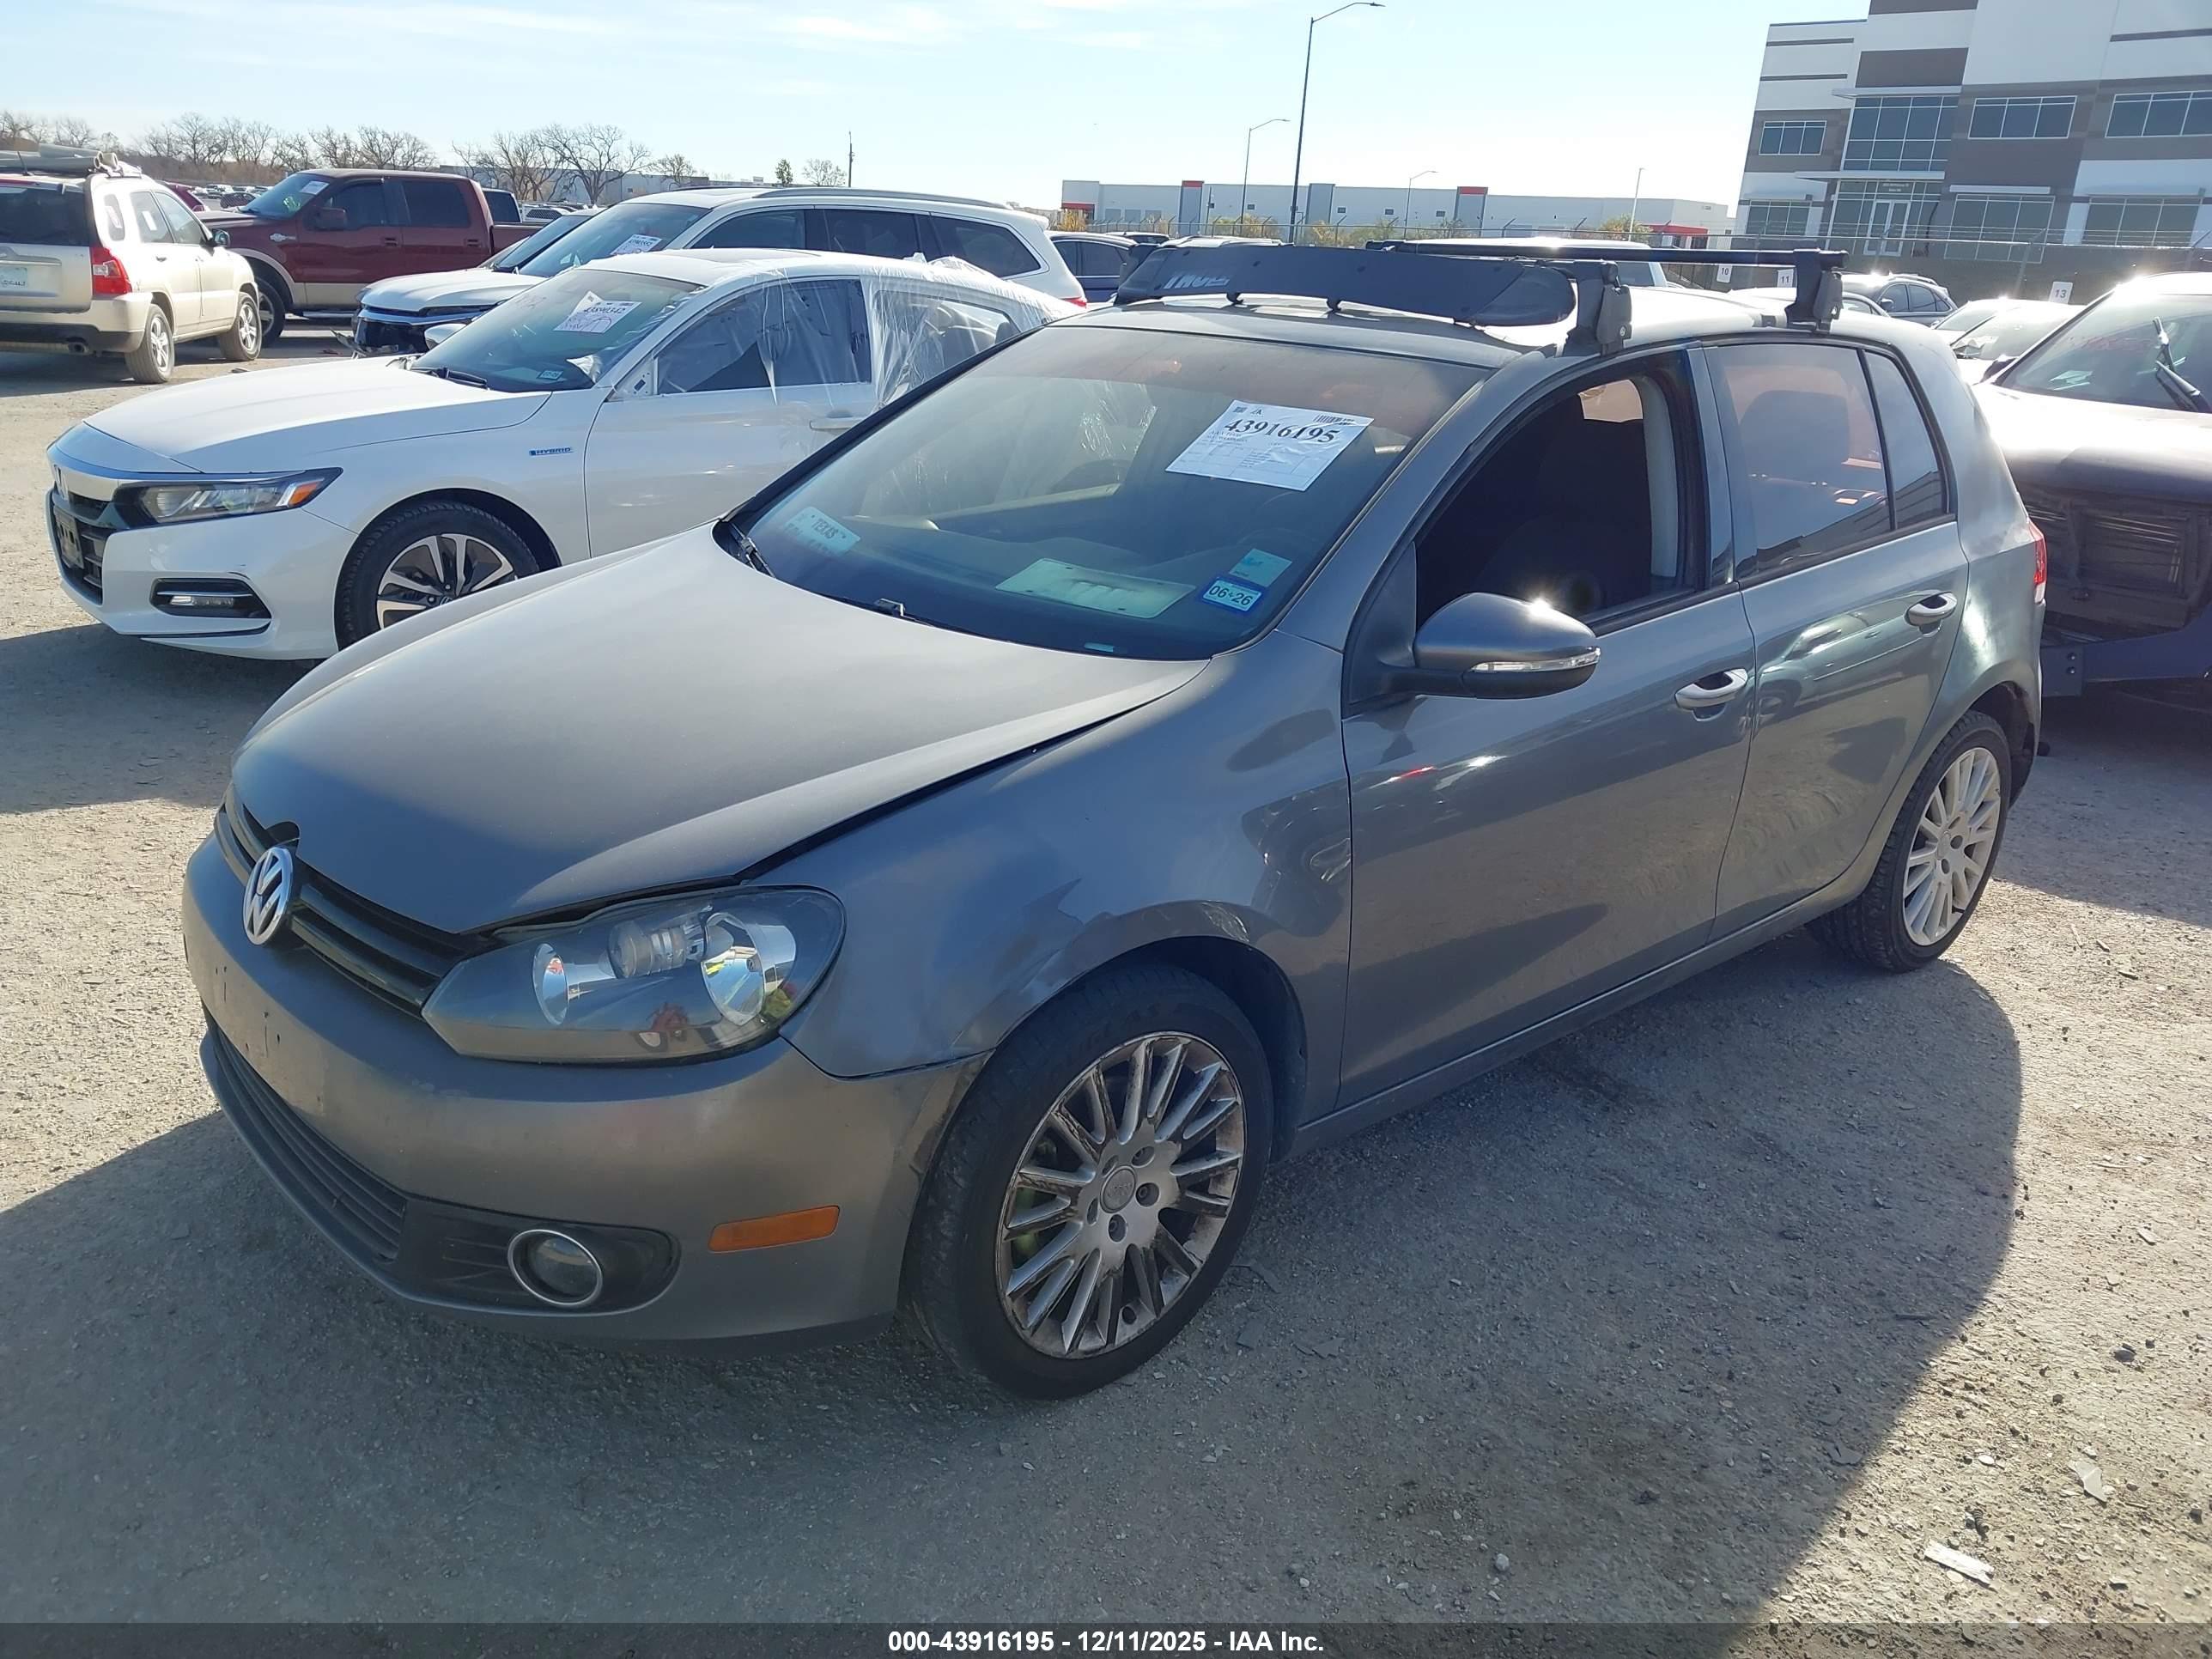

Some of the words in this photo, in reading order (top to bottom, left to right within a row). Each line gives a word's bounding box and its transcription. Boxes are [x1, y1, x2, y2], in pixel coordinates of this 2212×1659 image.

[1721, 267, 1729, 276] 10
[2056, 289, 2067, 298] 13
[1223, 417, 1340, 443] 43916195
